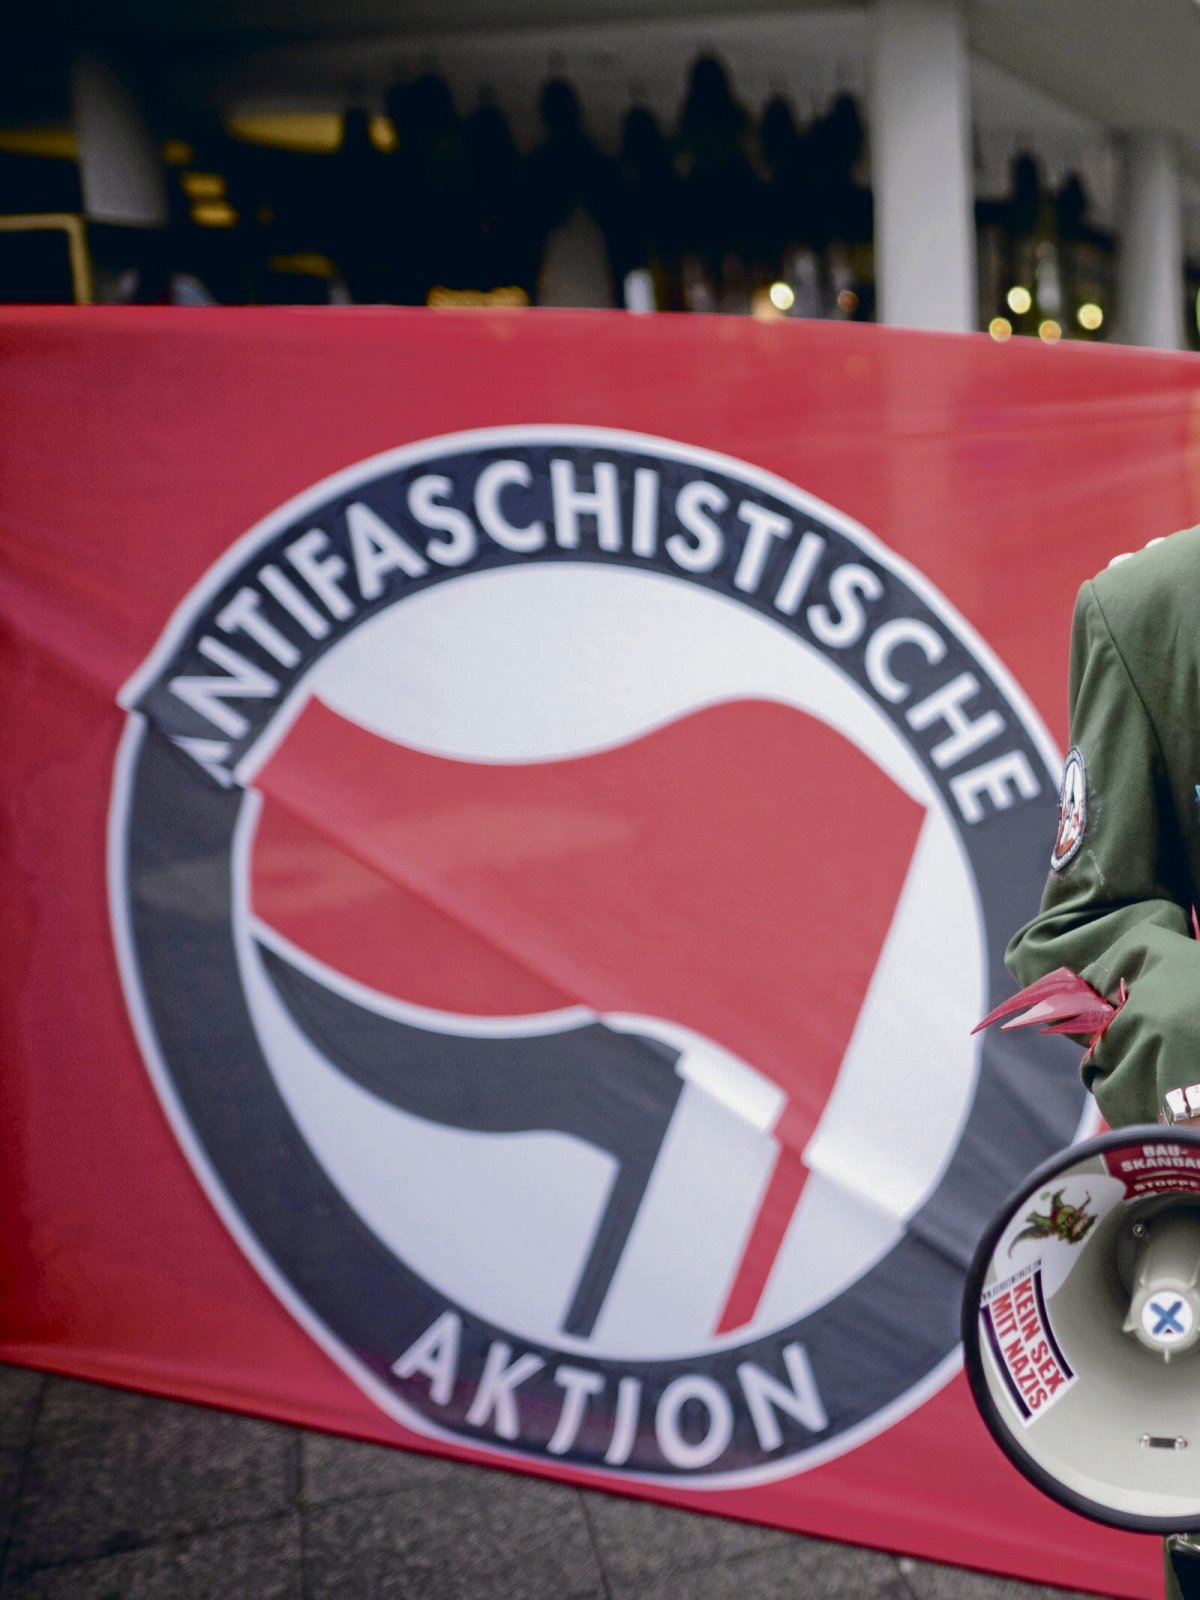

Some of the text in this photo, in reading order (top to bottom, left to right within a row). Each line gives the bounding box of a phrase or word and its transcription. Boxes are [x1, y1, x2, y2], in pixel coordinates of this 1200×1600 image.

[1142, 1143, 1190, 1157] BAU-
[991, 1291, 1019, 1339] MIT
[1013, 1278, 1066, 1395] KEIN SEX
[392, 1311, 830, 1470] AKTION
[1004, 1337, 1049, 1411] NAZIS
